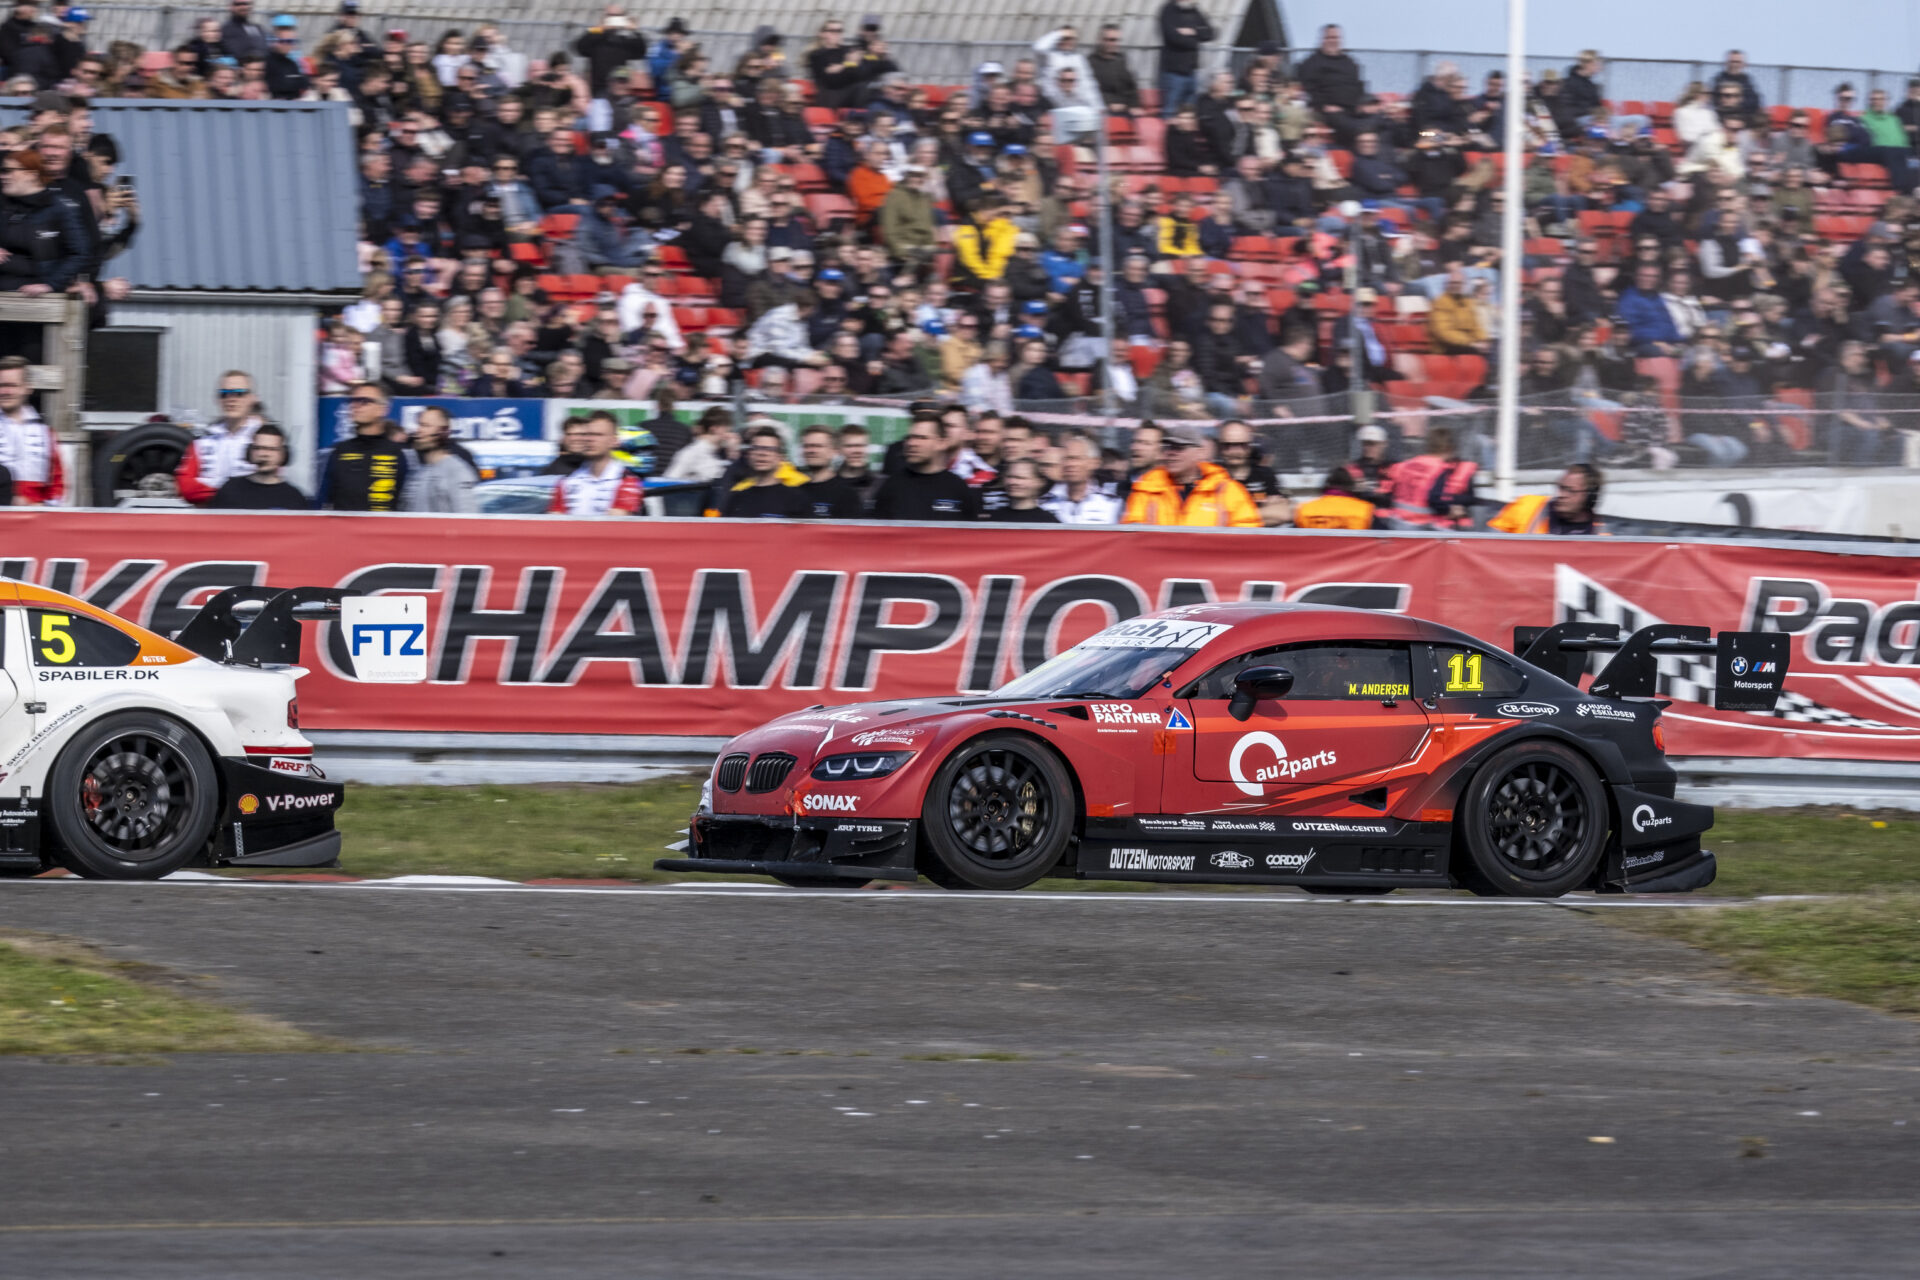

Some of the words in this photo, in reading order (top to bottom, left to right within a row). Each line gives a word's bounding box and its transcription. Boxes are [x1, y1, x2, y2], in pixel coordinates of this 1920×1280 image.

[41, 615, 76, 663] 5
[352, 624, 424, 656] FTZ
[39, 670, 160, 681] SPABILER.DK
[1446, 654, 1483, 691] 11
[1349, 683, 1359, 695] M.
[1361, 683, 1410, 696] ANDERSEN
[1734, 680, 1773, 690] Motorsport
[1090, 704, 1133, 713] EXPO
[1589, 703, 1612, 711] HUGO
[1094, 712, 1162, 724] PARTNER
[1592, 709, 1636, 719] ESKILDSEN
[272, 760, 304, 772] MRF
[1256, 750, 1337, 782] au2parts
[266, 793, 335, 811] V-Power
[1212, 822, 1259, 830] Autoteknik
[1641, 816, 1672, 827] au2parts
[1265, 854, 1308, 866] GORDON
